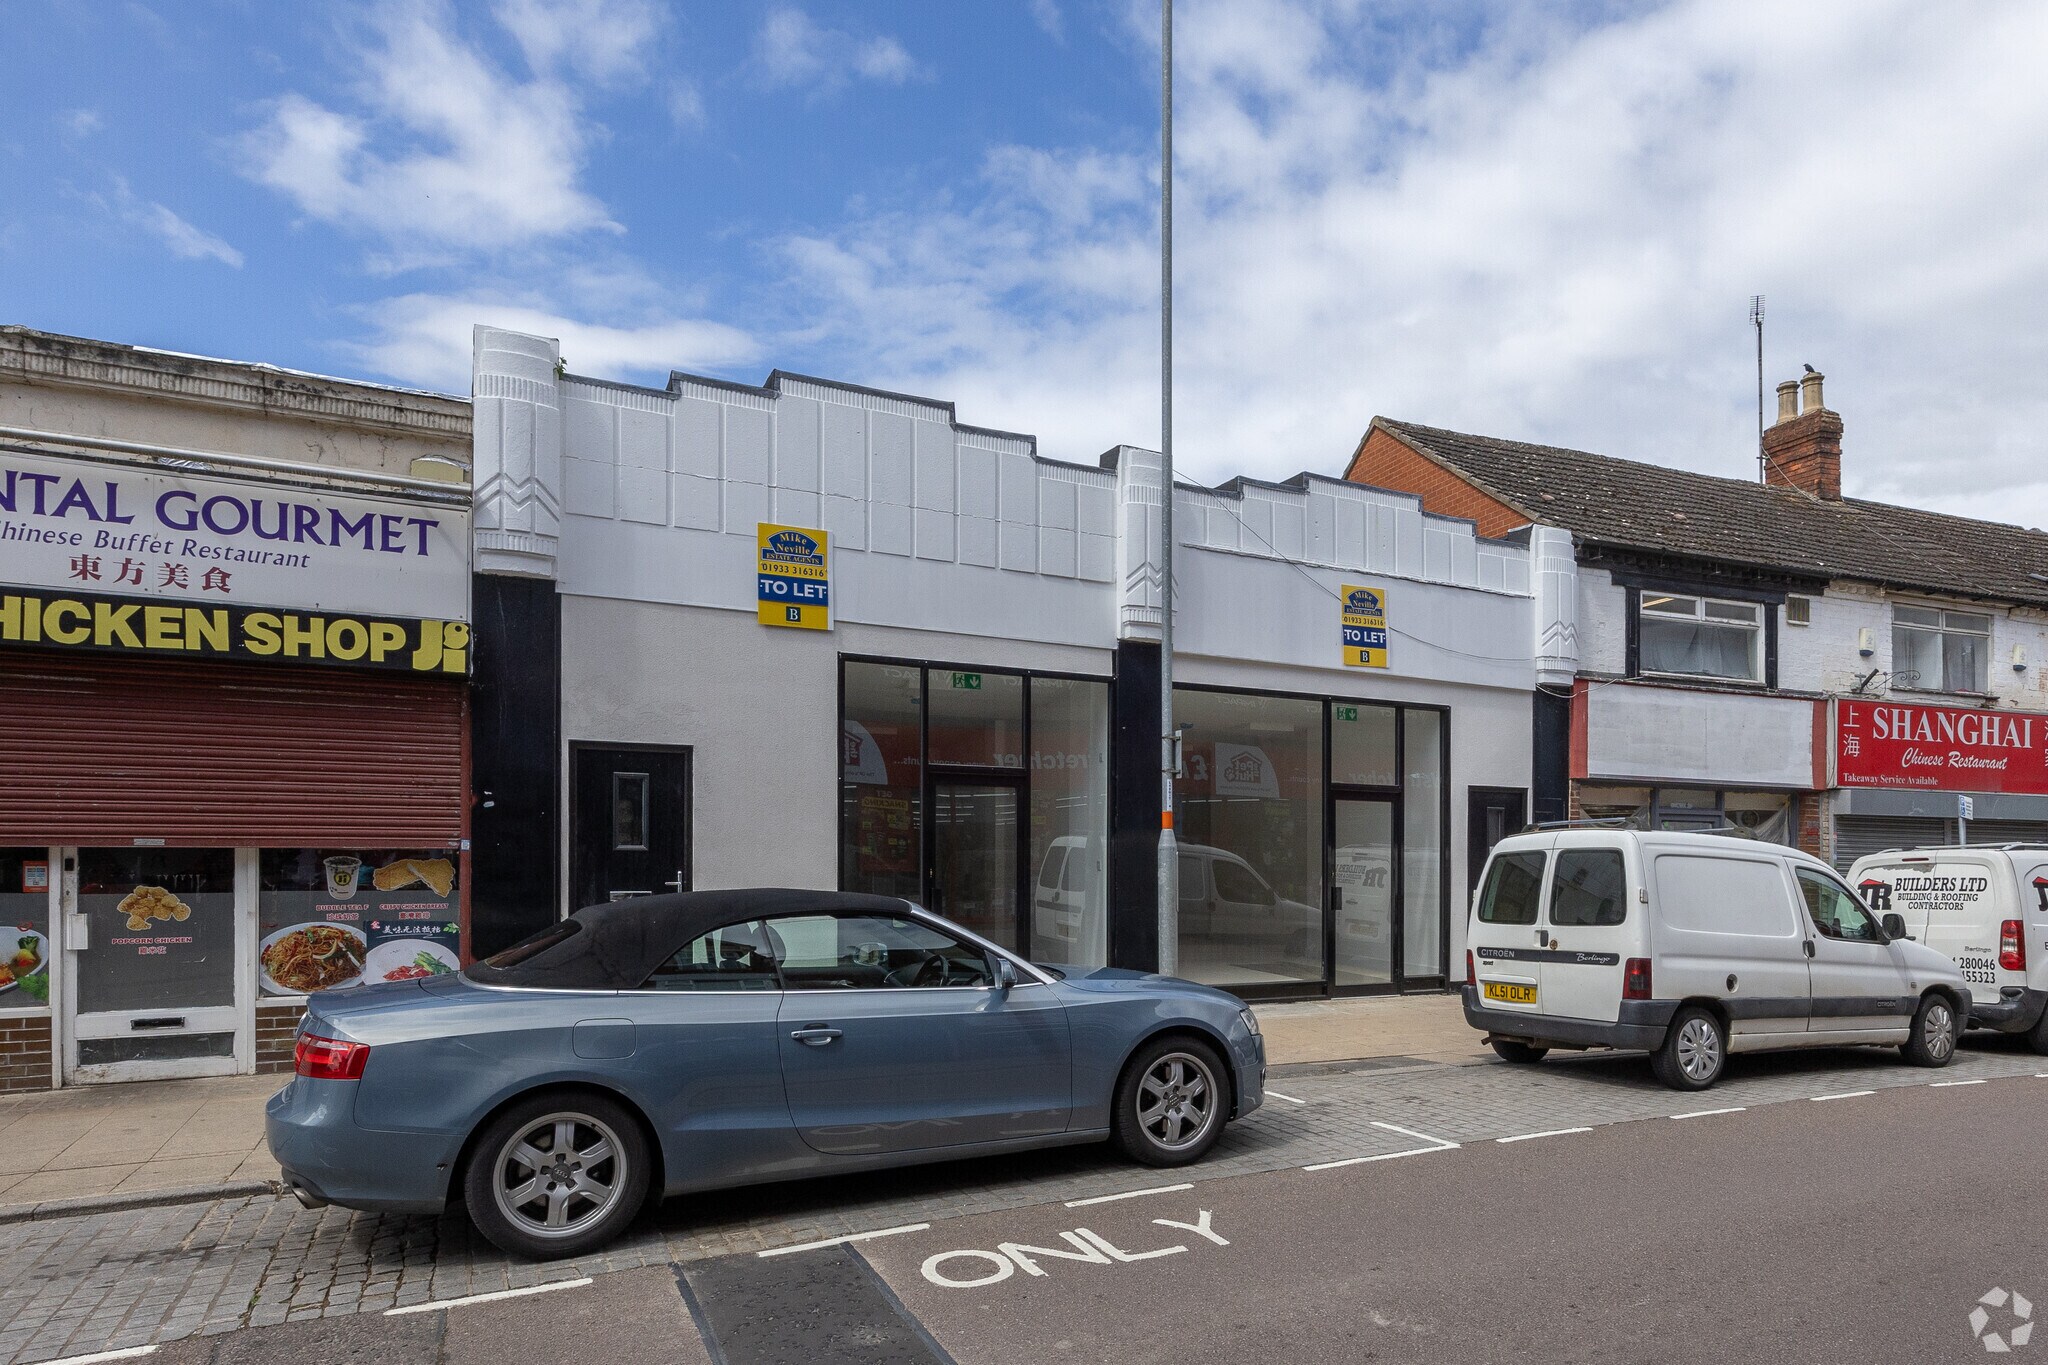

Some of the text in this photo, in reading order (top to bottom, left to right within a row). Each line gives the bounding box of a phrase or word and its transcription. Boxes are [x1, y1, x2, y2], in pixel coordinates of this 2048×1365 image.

[155, 489, 440, 557] GOURMET
[0, 520, 311, 569] hinese Buffet Restaurant
[780, 532, 807, 545] Mike
[776, 543, 811, 555] Neville
[766, 552, 820, 564] ESTATE AGENTS
[68, 553, 233, 594] 東方美食
[762, 563, 824, 577] 01933 316316
[760, 579, 827, 599] TO LET
[1355, 591, 1373, 601] Mike
[1353, 599, 1375, 609] Neville
[1343, 616, 1383, 627] 01933 316316
[244, 611, 407, 662] SHOP
[1344, 629, 1385, 644] TO LET
[1843, 705, 1860, 758] 上海
[1872, 706, 2033, 749] SHANGHAI
[1901, 747, 2008, 770] Chinese Restaurant
[1843, 772, 1939, 786] Takeaway Service Available
[1894, 877, 1957, 892] BUILDERS
[1959, 877, 1988, 892] LTD
[1898, 893, 1979, 902] BUILDING & ROOFING
[379, 903, 400, 911] CRISPY
[1908, 901, 1964, 911] CONTRACTORS
[112, 936, 193, 945] POPCORN CHICKEN
[1481, 949, 1515, 958] CITROËN
[1576, 952, 1610, 964] Berlingo
[1959, 957, 1996, 970] 280046
[1489, 984, 1530, 1000] KL51 OLR
[920, 1207, 1230, 1288] ONLY
